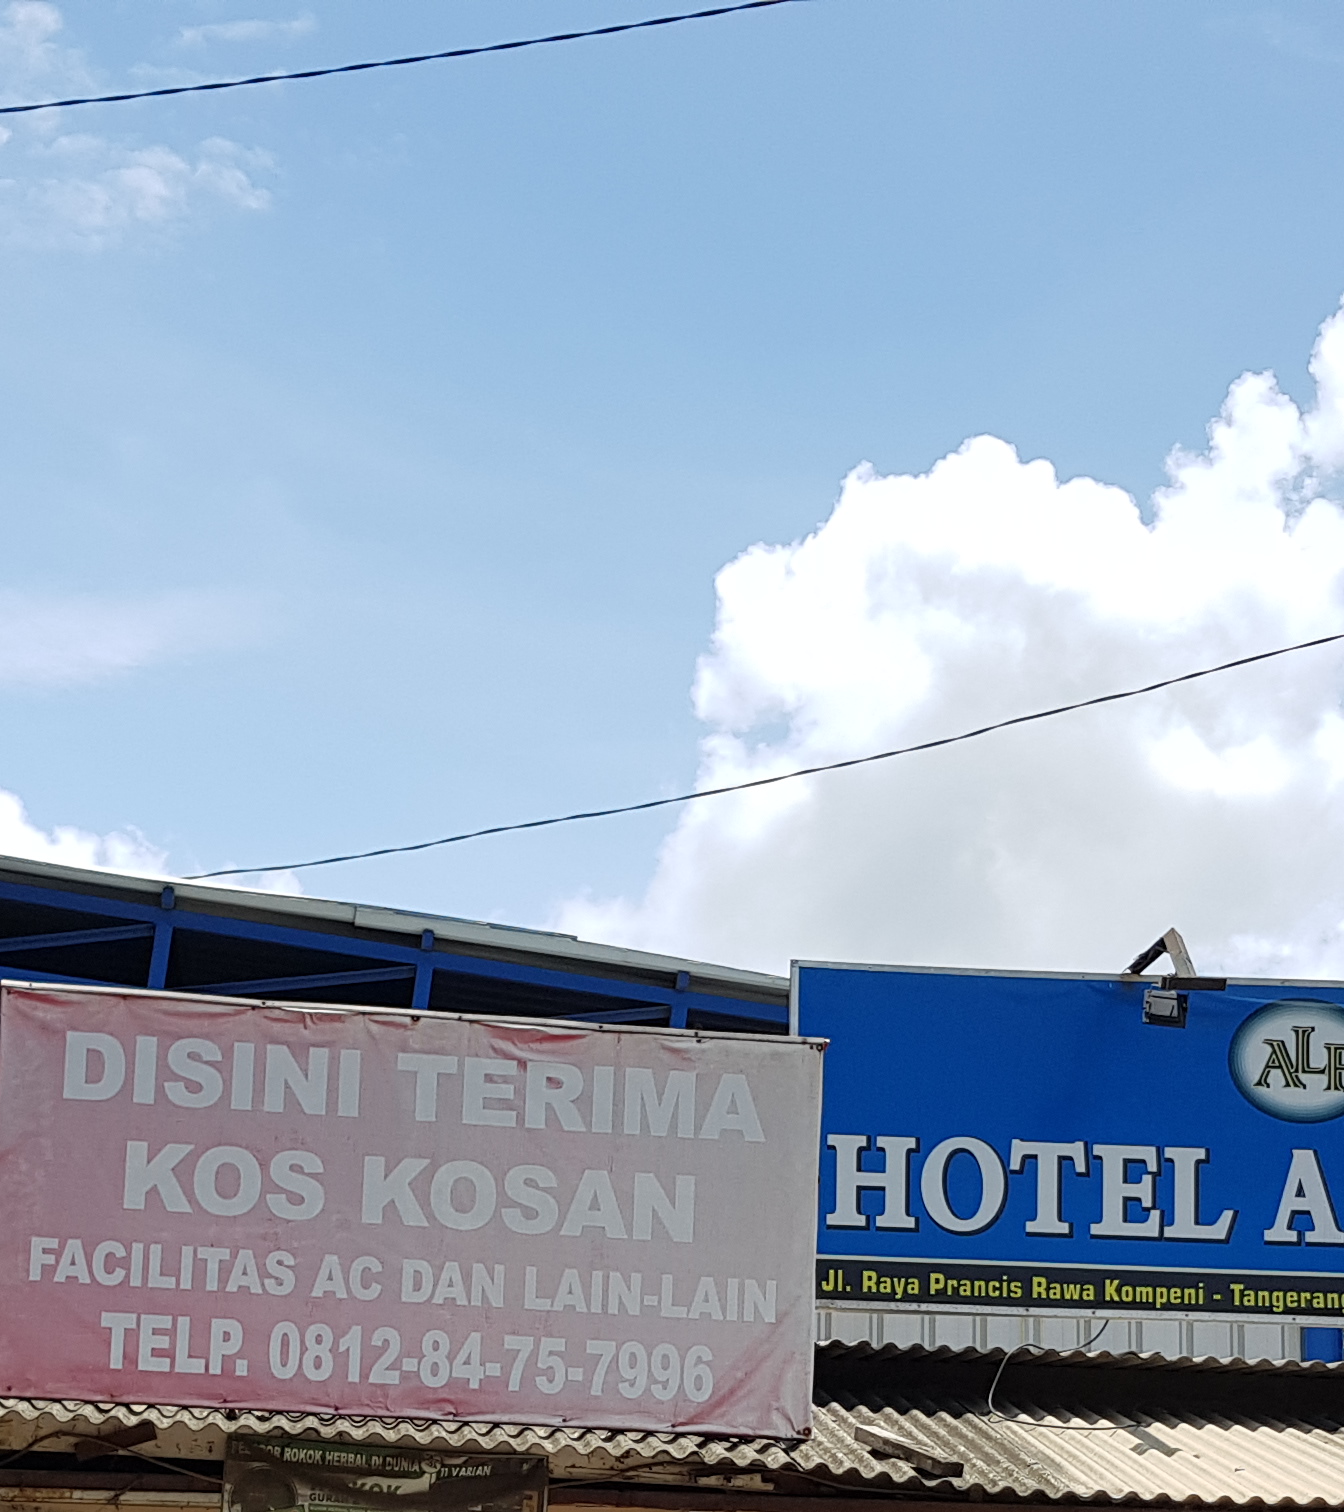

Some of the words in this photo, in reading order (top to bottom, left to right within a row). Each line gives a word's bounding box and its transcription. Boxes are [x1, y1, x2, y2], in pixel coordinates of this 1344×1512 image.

[62, 1030, 362, 1118] DISINI
[396, 1051, 766, 1143] TERIMA
[122, 1139, 324, 1222] KOS
[361, 1154, 696, 1244] KOSAN
[825, 1133, 1238, 1245] HOTEL
[28, 1235, 296, 1298] FACILITAS
[311, 1253, 383, 1304] AC
[400, 1259, 505, 1310] DAN
[523, 1264, 777, 1325] LAIN-LAIN
[820, 1268, 851, 1293] Jl.
[862, 1270, 919, 1300] Raya
[929, 1272, 1022, 1299] Prancis
[1032, 1275, 1095, 1302] Rawa
[1104, 1278, 1205, 1307] Kompeni
[100, 1312, 248, 1378] TELP.
[267, 1322, 714, 1403] 0812-84-75-7996
[283, 1448, 323, 1465] ROKOK
[325, 1452, 369, 1470] HERBAL
[371, 1457, 384, 1470] DI
[385, 1457, 422, 1474] DUNIA
